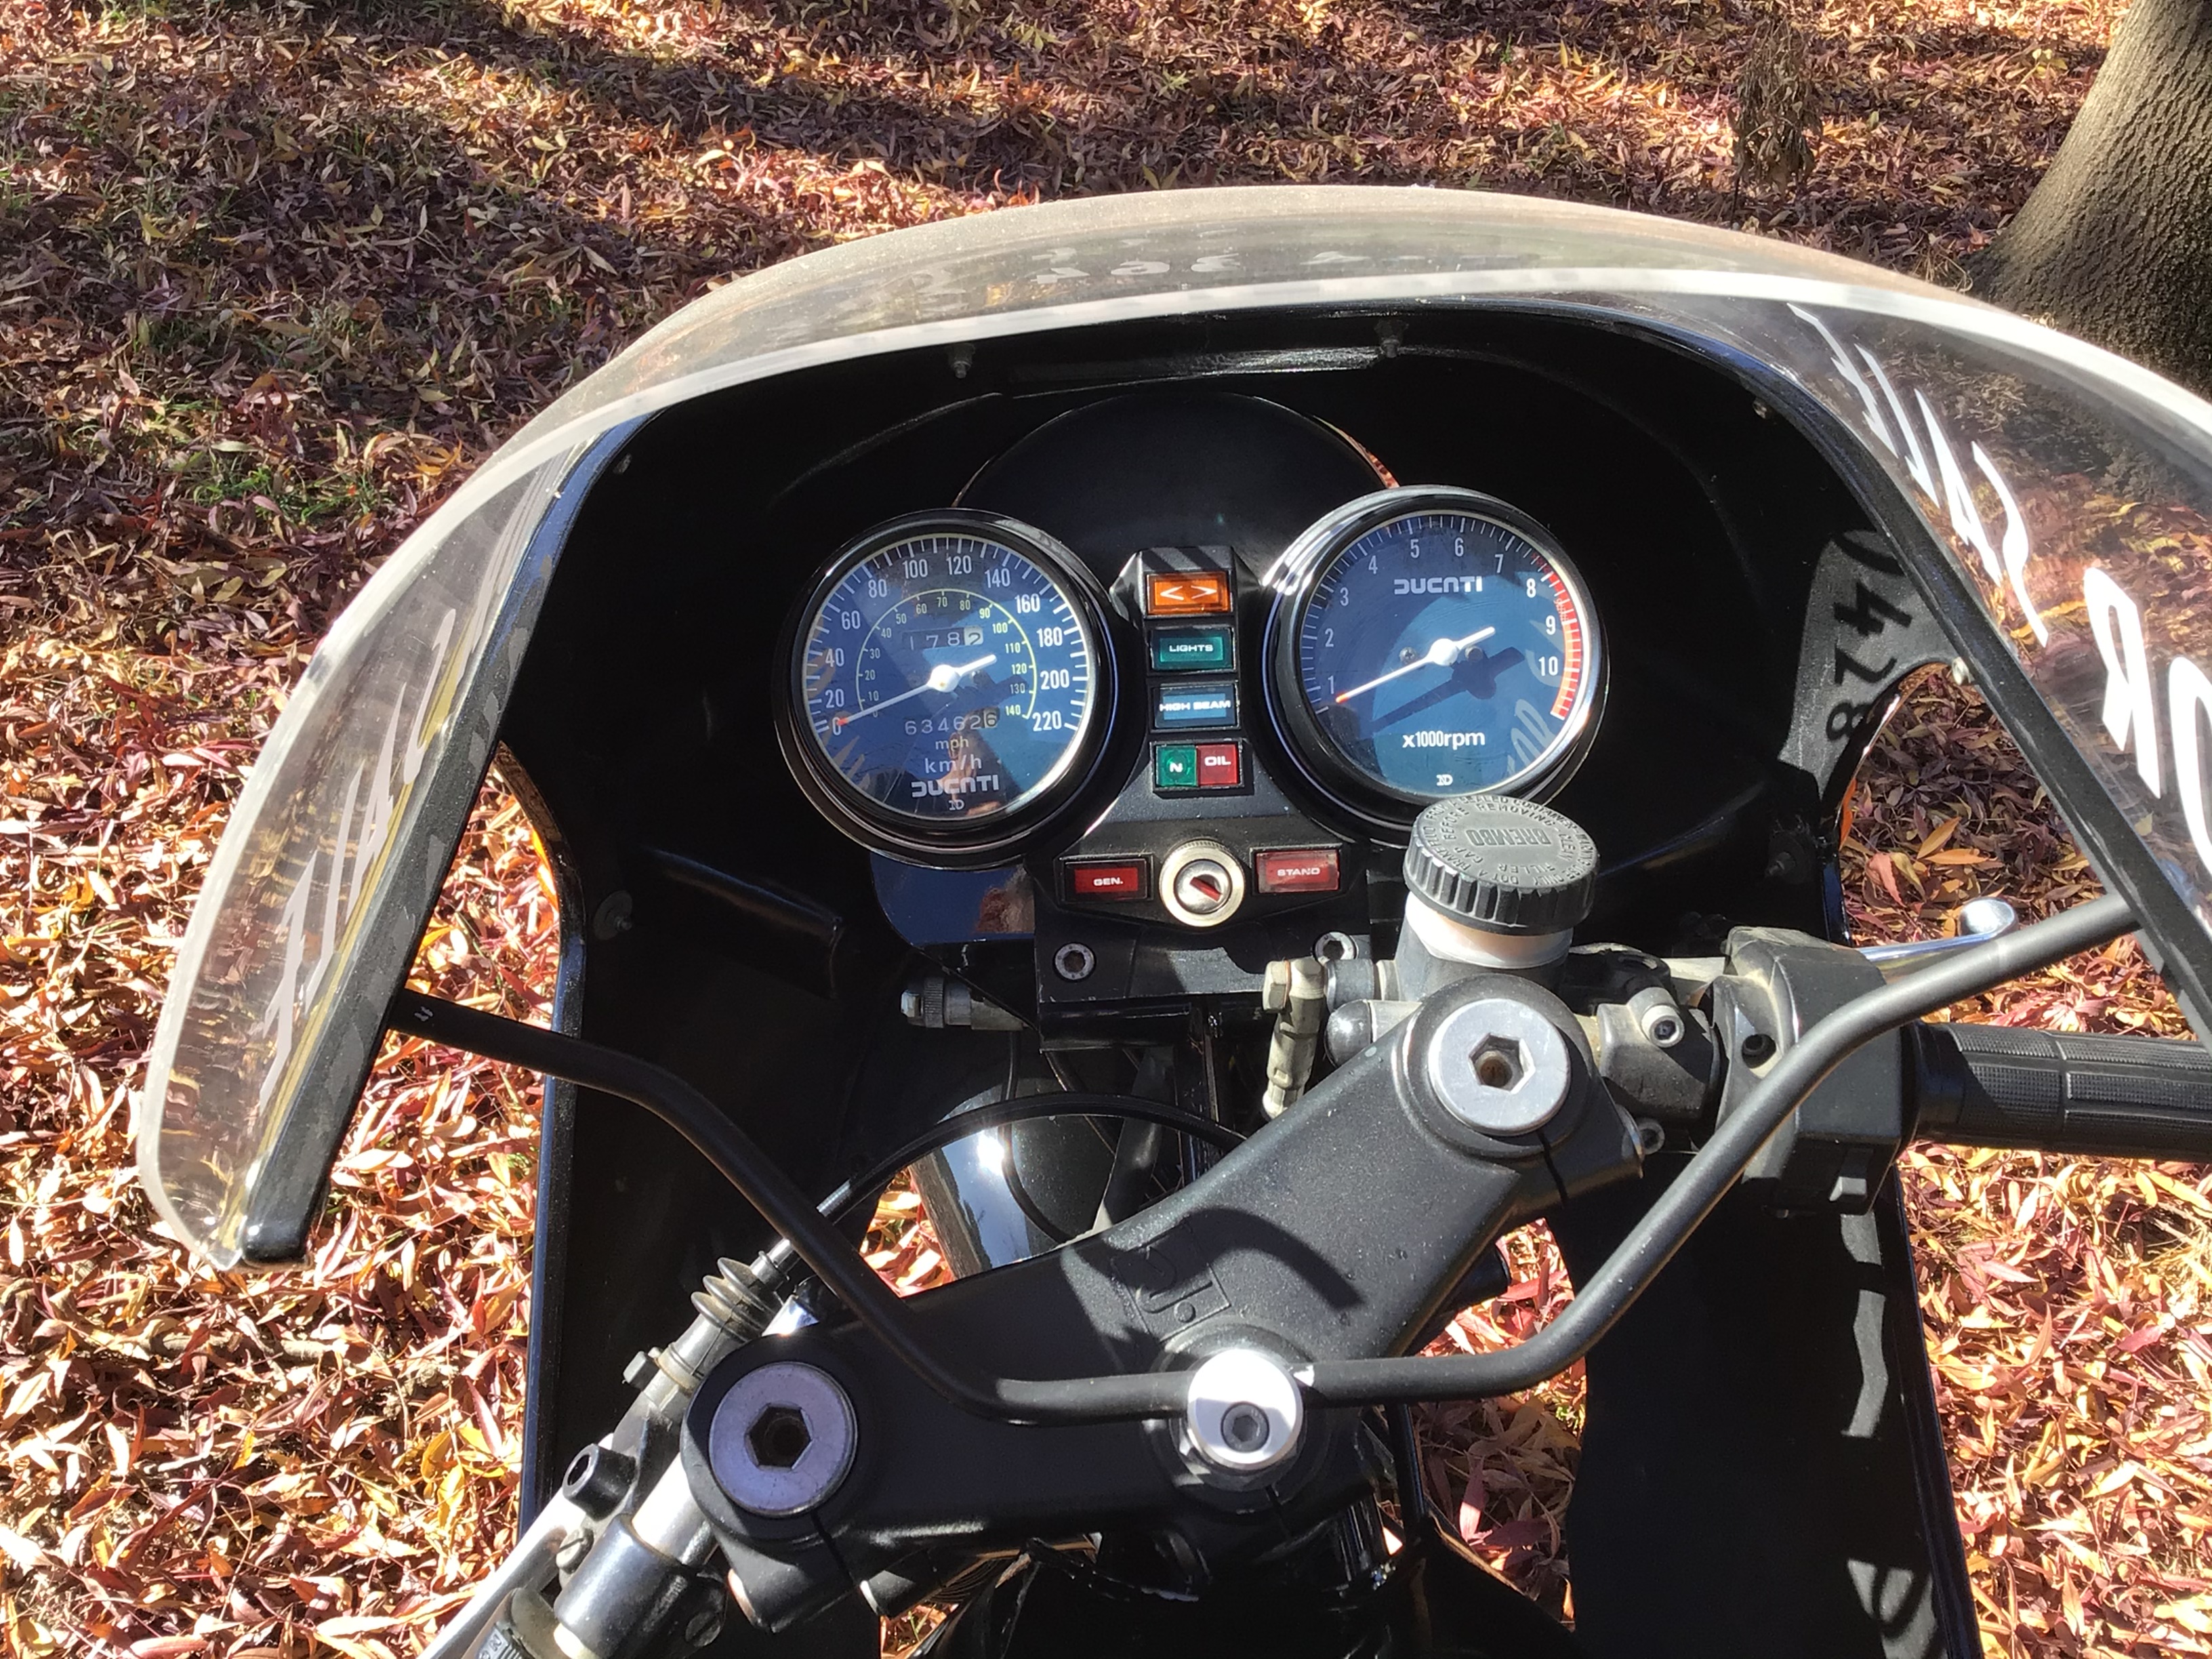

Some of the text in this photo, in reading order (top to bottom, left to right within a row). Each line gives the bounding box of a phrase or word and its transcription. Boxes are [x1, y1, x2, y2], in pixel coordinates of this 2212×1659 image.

[1410, 539, 1420, 558] 5
[1454, 538, 1464, 556] 6
[902, 558, 928, 578] 100
[947, 556, 972, 575] 120
[1368, 555, 1378, 574] 4
[1495, 554, 1504, 573] 7
[985, 569, 1010, 588] 140
[1394, 576, 1482, 595] DUCATI
[867, 580, 888, 598] 80
[1340, 587, 1349, 606] 3
[1526, 579, 1536, 598] 8
[916, 604, 927, 615] 60
[937, 597, 947, 608] 70
[960, 600, 970, 610] 80
[1015, 594, 1040, 613] 160
[841, 611, 861, 630] 60
[896, 614, 907, 624] 50
[979, 608, 991, 619] 90
[881, 628, 891, 638] 40
[992, 623, 1008, 634] 100
[1546, 615, 1556, 635] 9
[1037, 627, 1063, 647] 180
[1325, 629, 1334, 648] 2
[869, 648, 880, 659] 30
[1005, 642, 1021, 653] 110
[1169, 643, 1214, 653] LIGHTS
[825, 648, 844, 667] 40
[1538, 657, 1559, 676] 10
[865, 670, 876, 680] 20
[1012, 663, 1027, 674] 120
[1010, 683, 1026, 694] 130
[1040, 670, 1070, 689] 200
[1328, 676, 1334, 694] 1
[825, 689, 844, 708] 20
[868, 691, 879, 701] 10
[1005, 705, 1022, 716] 140
[1160, 699, 1231, 712] HIGH BEAM
[832, 717, 842, 736] 0
[1033, 711, 1062, 732] 220
[935, 735, 969, 752] mph
[1402, 731, 1486, 750] x1000rpm
[924, 754, 982, 774] km/h
[1170, 756, 1231, 773] N OIL
[911, 775, 1000, 798] DUCATI
[1440, 806, 1470, 840] BEFORE
[1475, 803, 1556, 826] REMOVING
[1466, 828, 1551, 846] BREMBO
[1436, 846, 1471, 871] BRAKE
[1454, 847, 1483, 863] CAP
[1277, 866, 1320, 876] STAND
[1498, 863, 1556, 874] FILLER
[1093, 877, 1124, 886] GEN.
[1492, 873, 1519, 884] DOT
